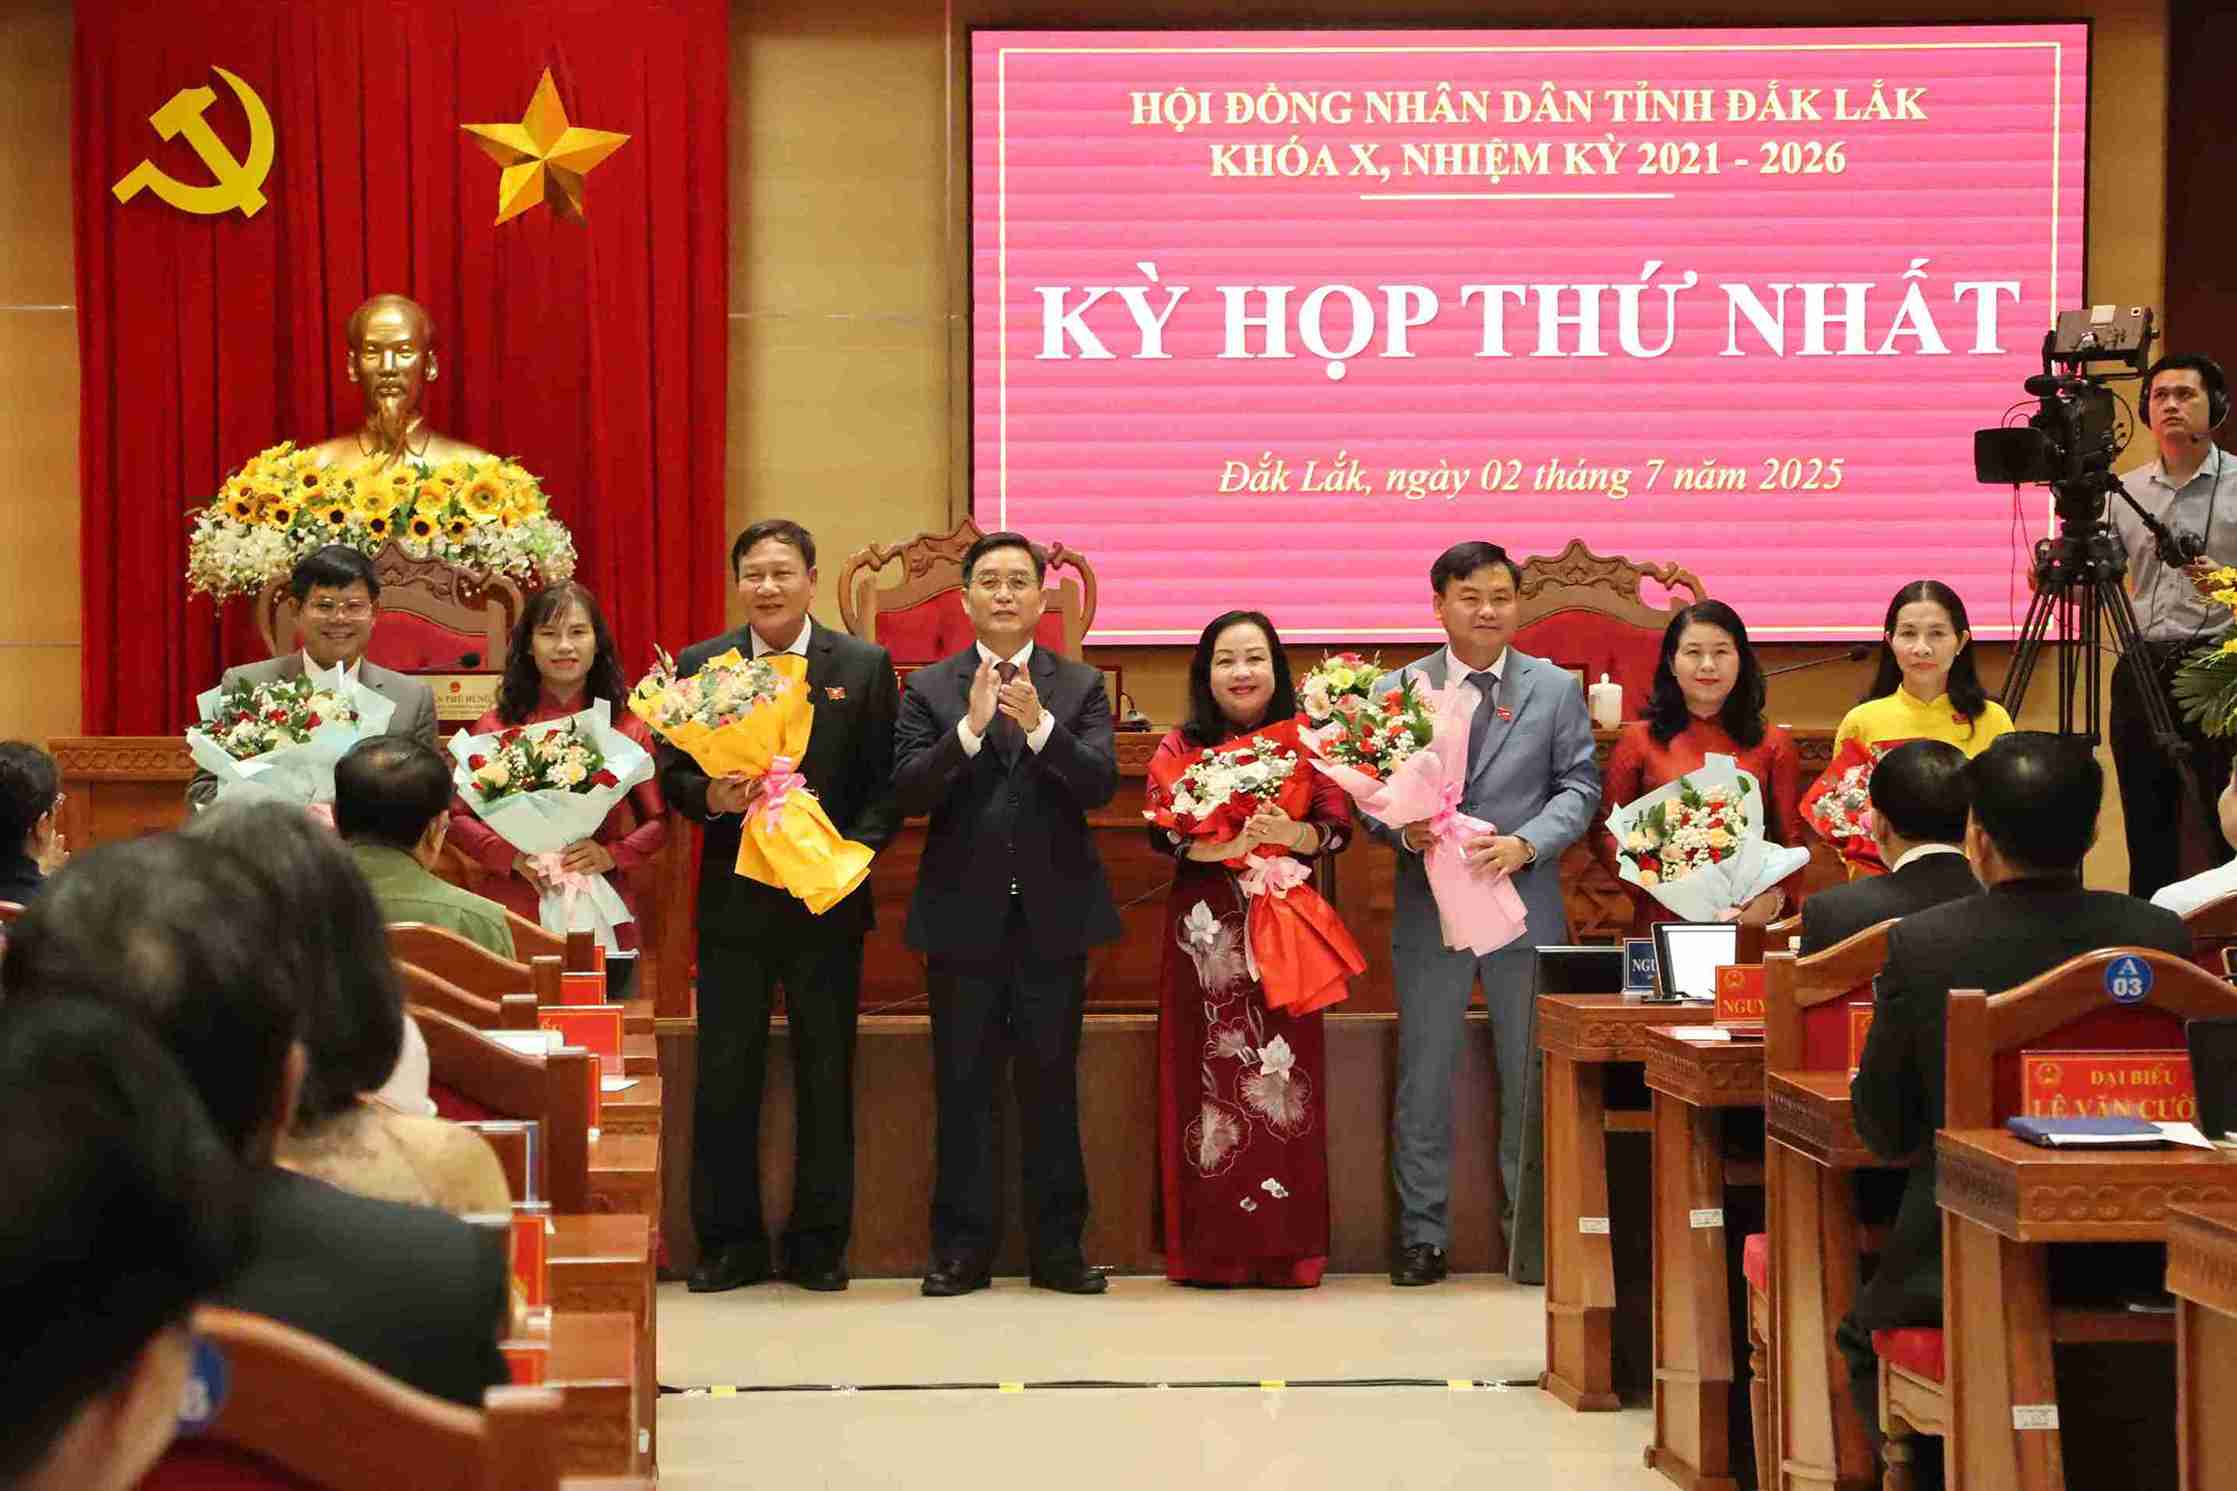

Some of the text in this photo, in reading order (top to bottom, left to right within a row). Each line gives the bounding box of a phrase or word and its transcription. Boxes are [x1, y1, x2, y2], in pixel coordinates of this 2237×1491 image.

[1129, 85, 1213, 132] HỘI
[1363, 81, 1490, 124] NHÂN
[1500, 80, 1594, 123] DÂN
[1604, 79, 1715, 123] TỈNH
[1727, 79, 1823, 122] ĐẮK
[1833, 78, 1928, 121] LẮK
[1208, 135, 1340, 177] KHÓA
[1348, 143, 1392, 183] X,
[1400, 137, 1553, 184] NHIỆM
[1562, 132, 1627, 176] KỲ
[1637, 142, 1721, 176] 2021
[1758, 140, 1847, 175] 2026
[1033, 257, 2021, 382] KỲ HỌP THỨ NHẤT
[1218, 449, 1846, 500] Đắk Lắk, ngày 02 tháng 7 năm 2025
[2112, 977, 2143, 997] 03
[2118, 957, 2139, 976] A
